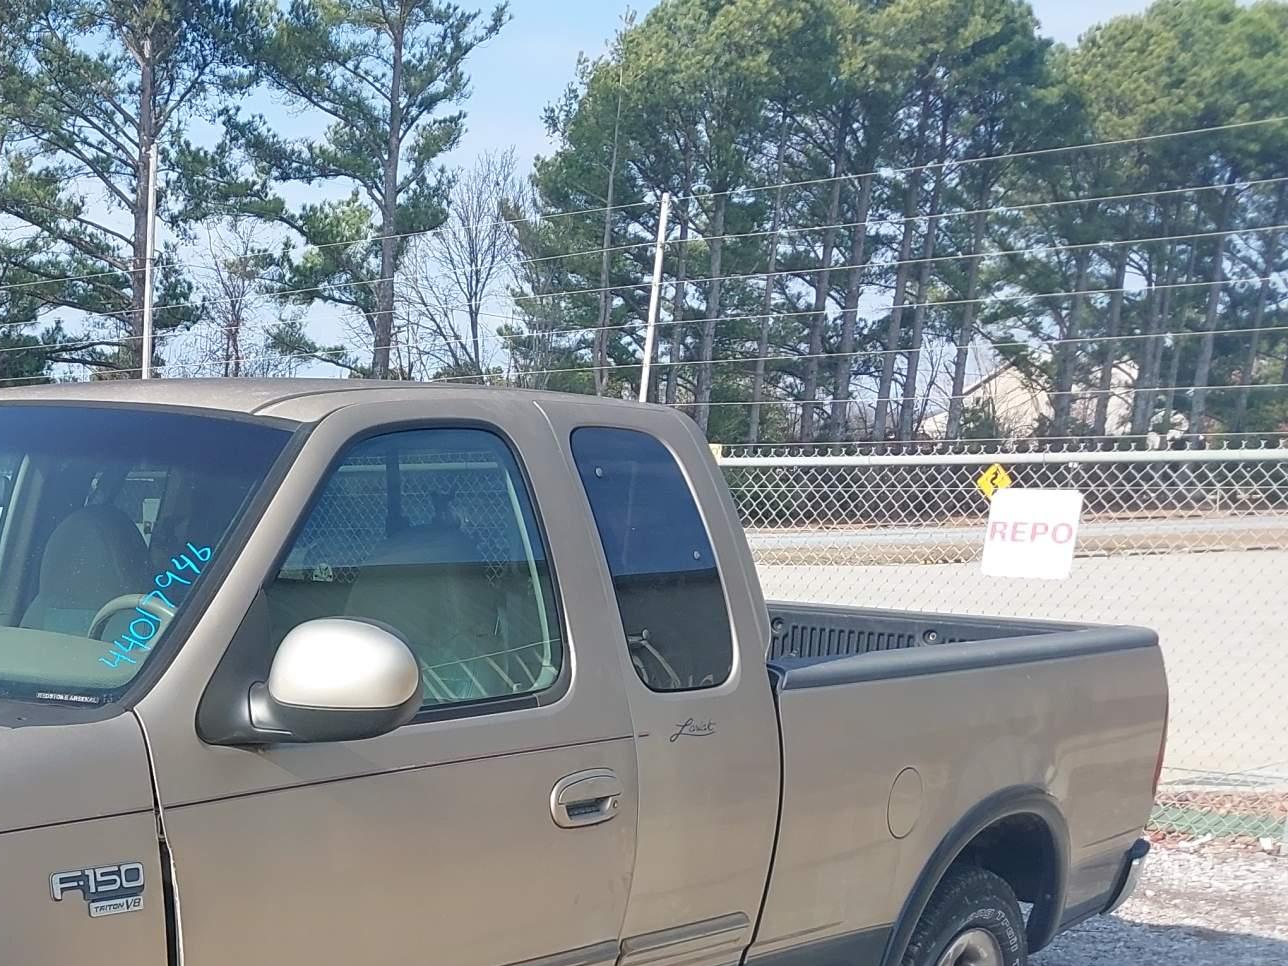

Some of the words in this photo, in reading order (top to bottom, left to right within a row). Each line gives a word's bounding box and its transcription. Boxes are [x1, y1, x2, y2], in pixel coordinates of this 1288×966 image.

[989, 521, 1074, 544] REPO
[98, 542, 212, 668] 44017946
[93, 902, 125, 913] TRITON
[125, 897, 142, 911] V8
